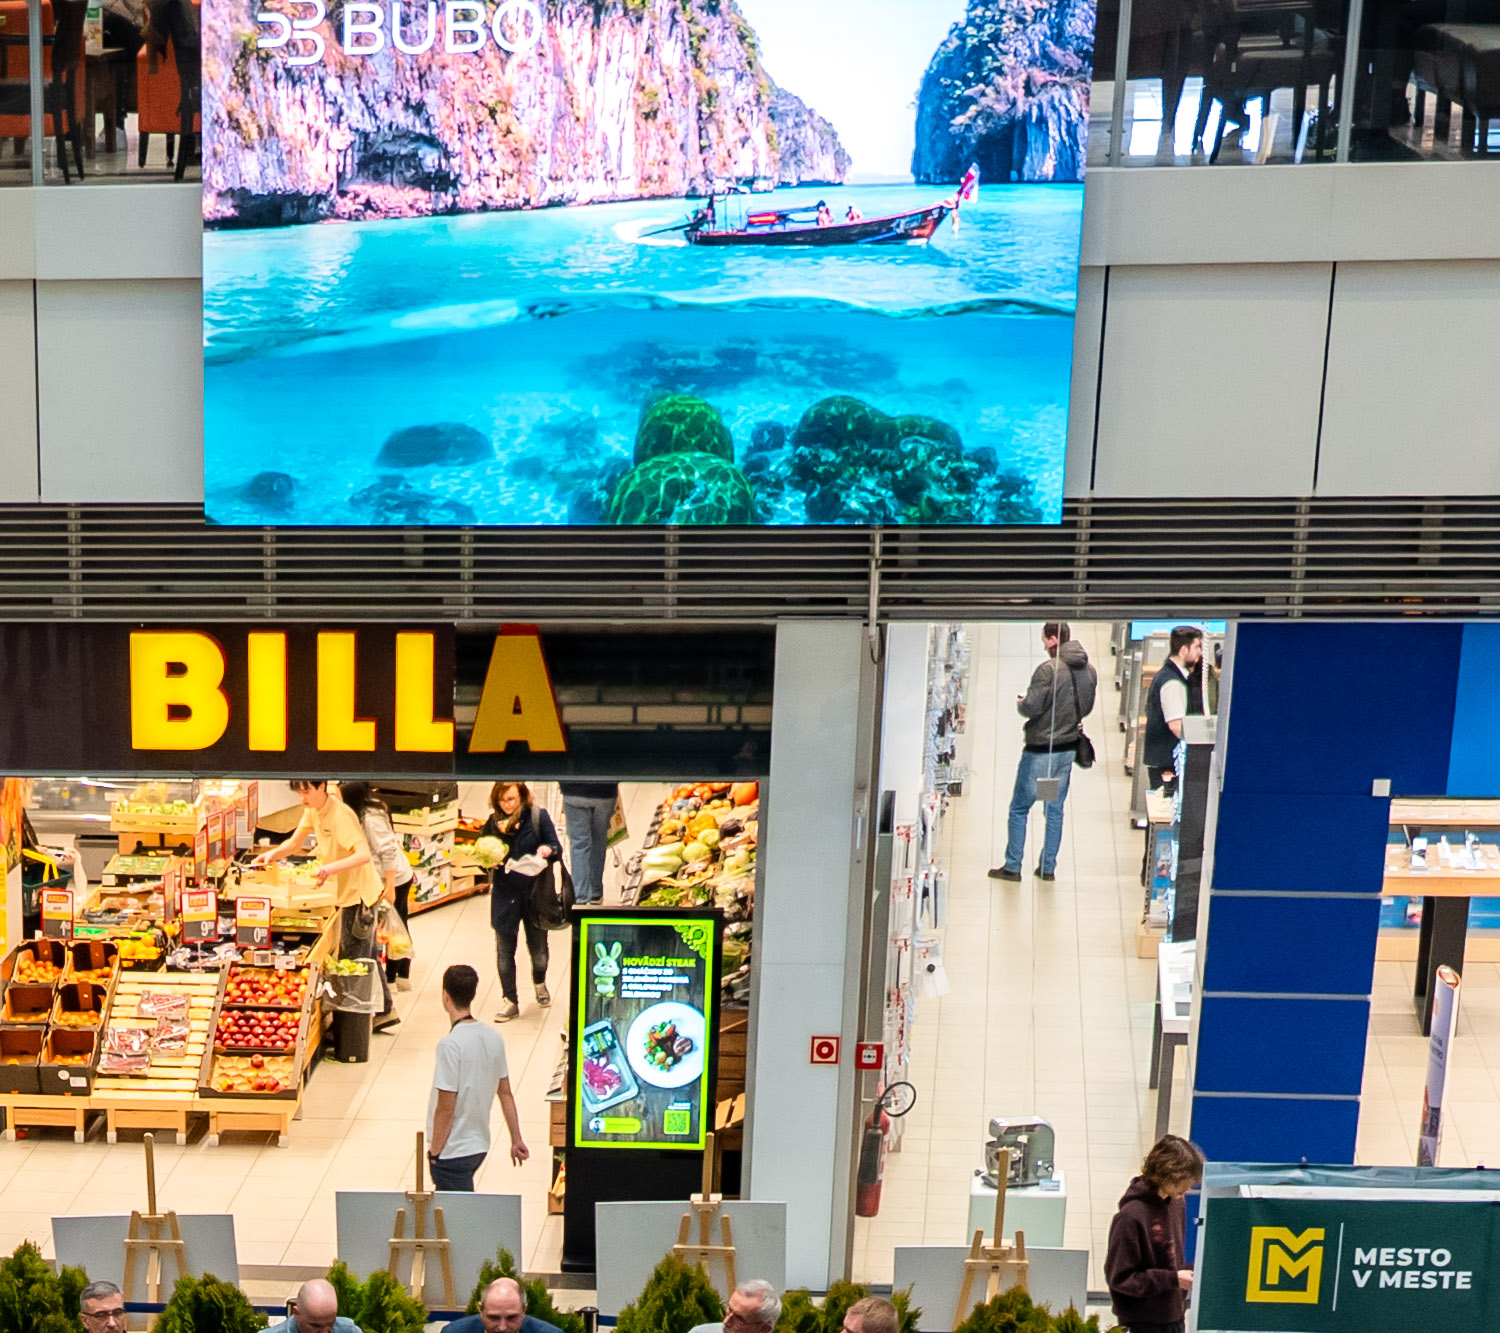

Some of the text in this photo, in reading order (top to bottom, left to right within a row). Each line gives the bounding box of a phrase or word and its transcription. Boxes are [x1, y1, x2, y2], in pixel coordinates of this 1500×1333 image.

[343, 0, 543, 57] BUBO
[129, 630, 567, 754] BILLA
[1354, 1247, 1452, 1268] MESTO
[1352, 1269, 1472, 1290] V MESTE
